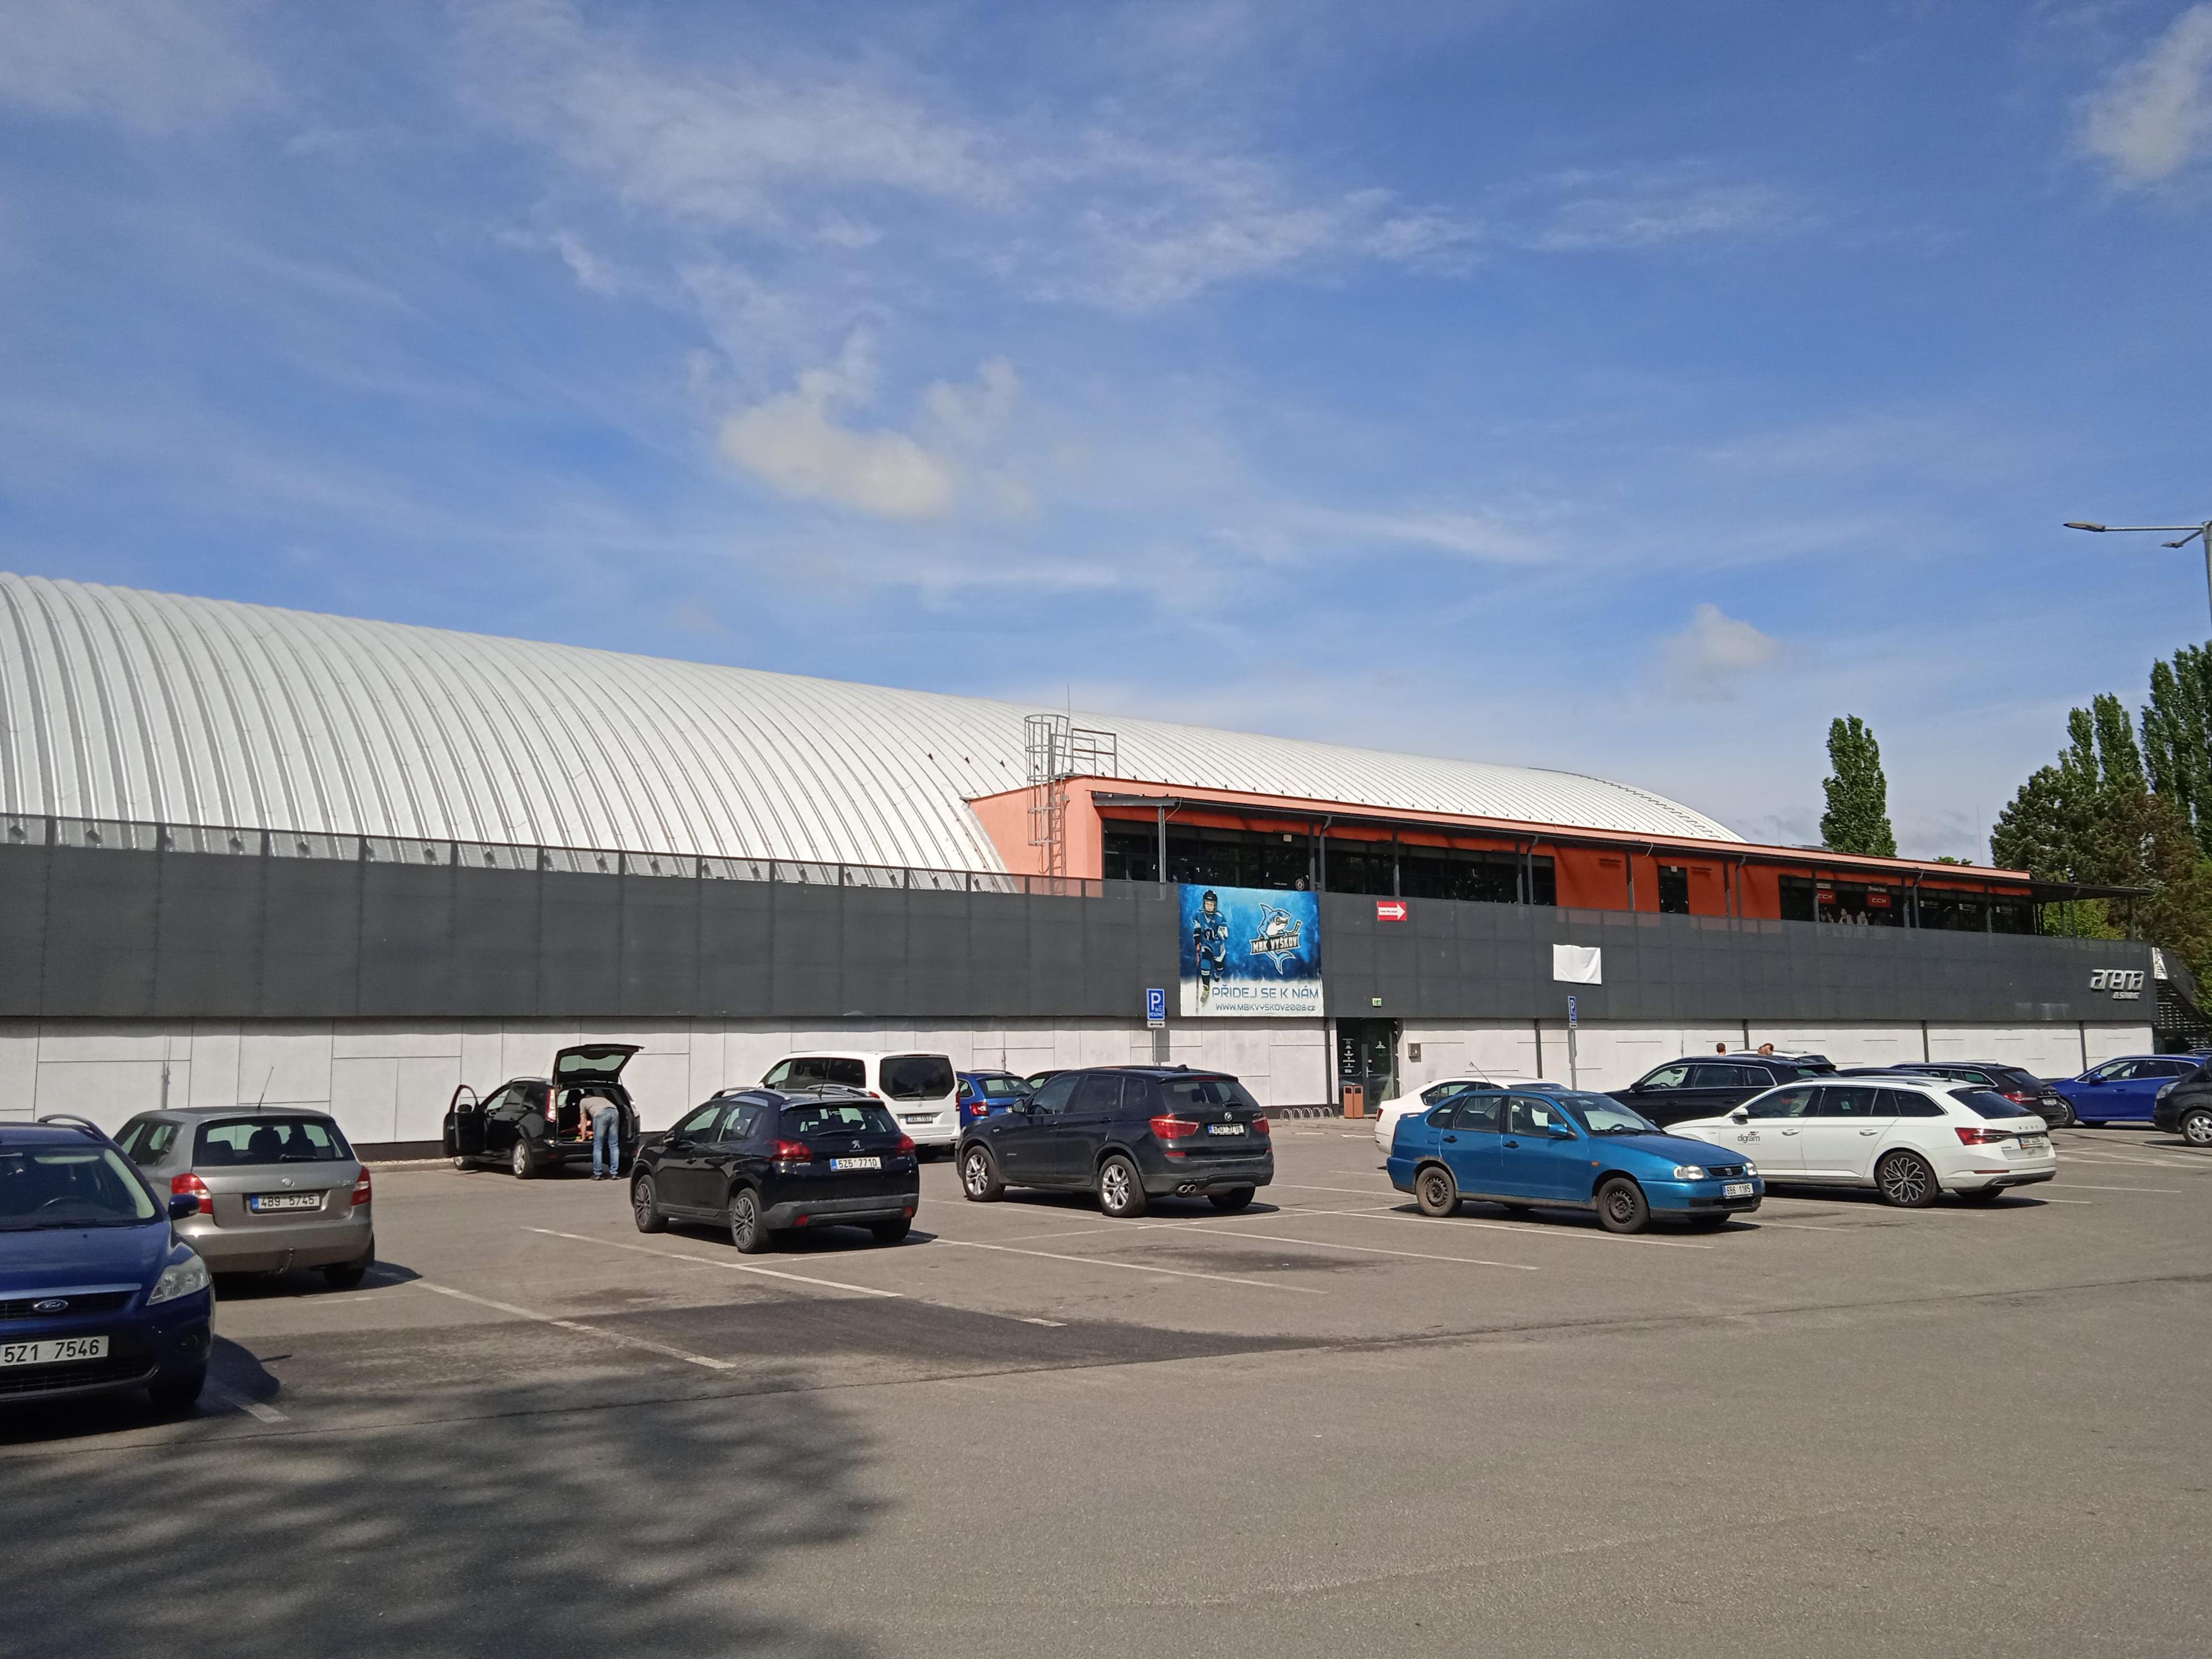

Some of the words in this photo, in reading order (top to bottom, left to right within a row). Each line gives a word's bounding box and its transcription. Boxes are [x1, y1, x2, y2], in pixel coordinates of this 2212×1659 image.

[1253, 940, 1268, 952] MBK
[1270, 936, 1297, 950] VYŠKOV
[2090, 969, 2145, 990] arena
[1212, 984, 1257, 998] PŘIDEJ
[1261, 987, 1276, 998] SE
[1280, 988, 1288, 999] K
[1292, 985, 1319, 999] NÁM
[1151, 992, 1161, 1011] P
[1571, 999, 1575, 1014] P
[1738, 1134, 1760, 1143] digram
[838, 1159, 853, 1168] 5Z5
[858, 1158, 878, 1167] 7710
[261, 1196, 280, 1207] 4B9
[289, 1194, 315, 1206] 5745
[4, 1344, 39, 1363] 5Z1
[55, 1338, 100, 1359] 7546
